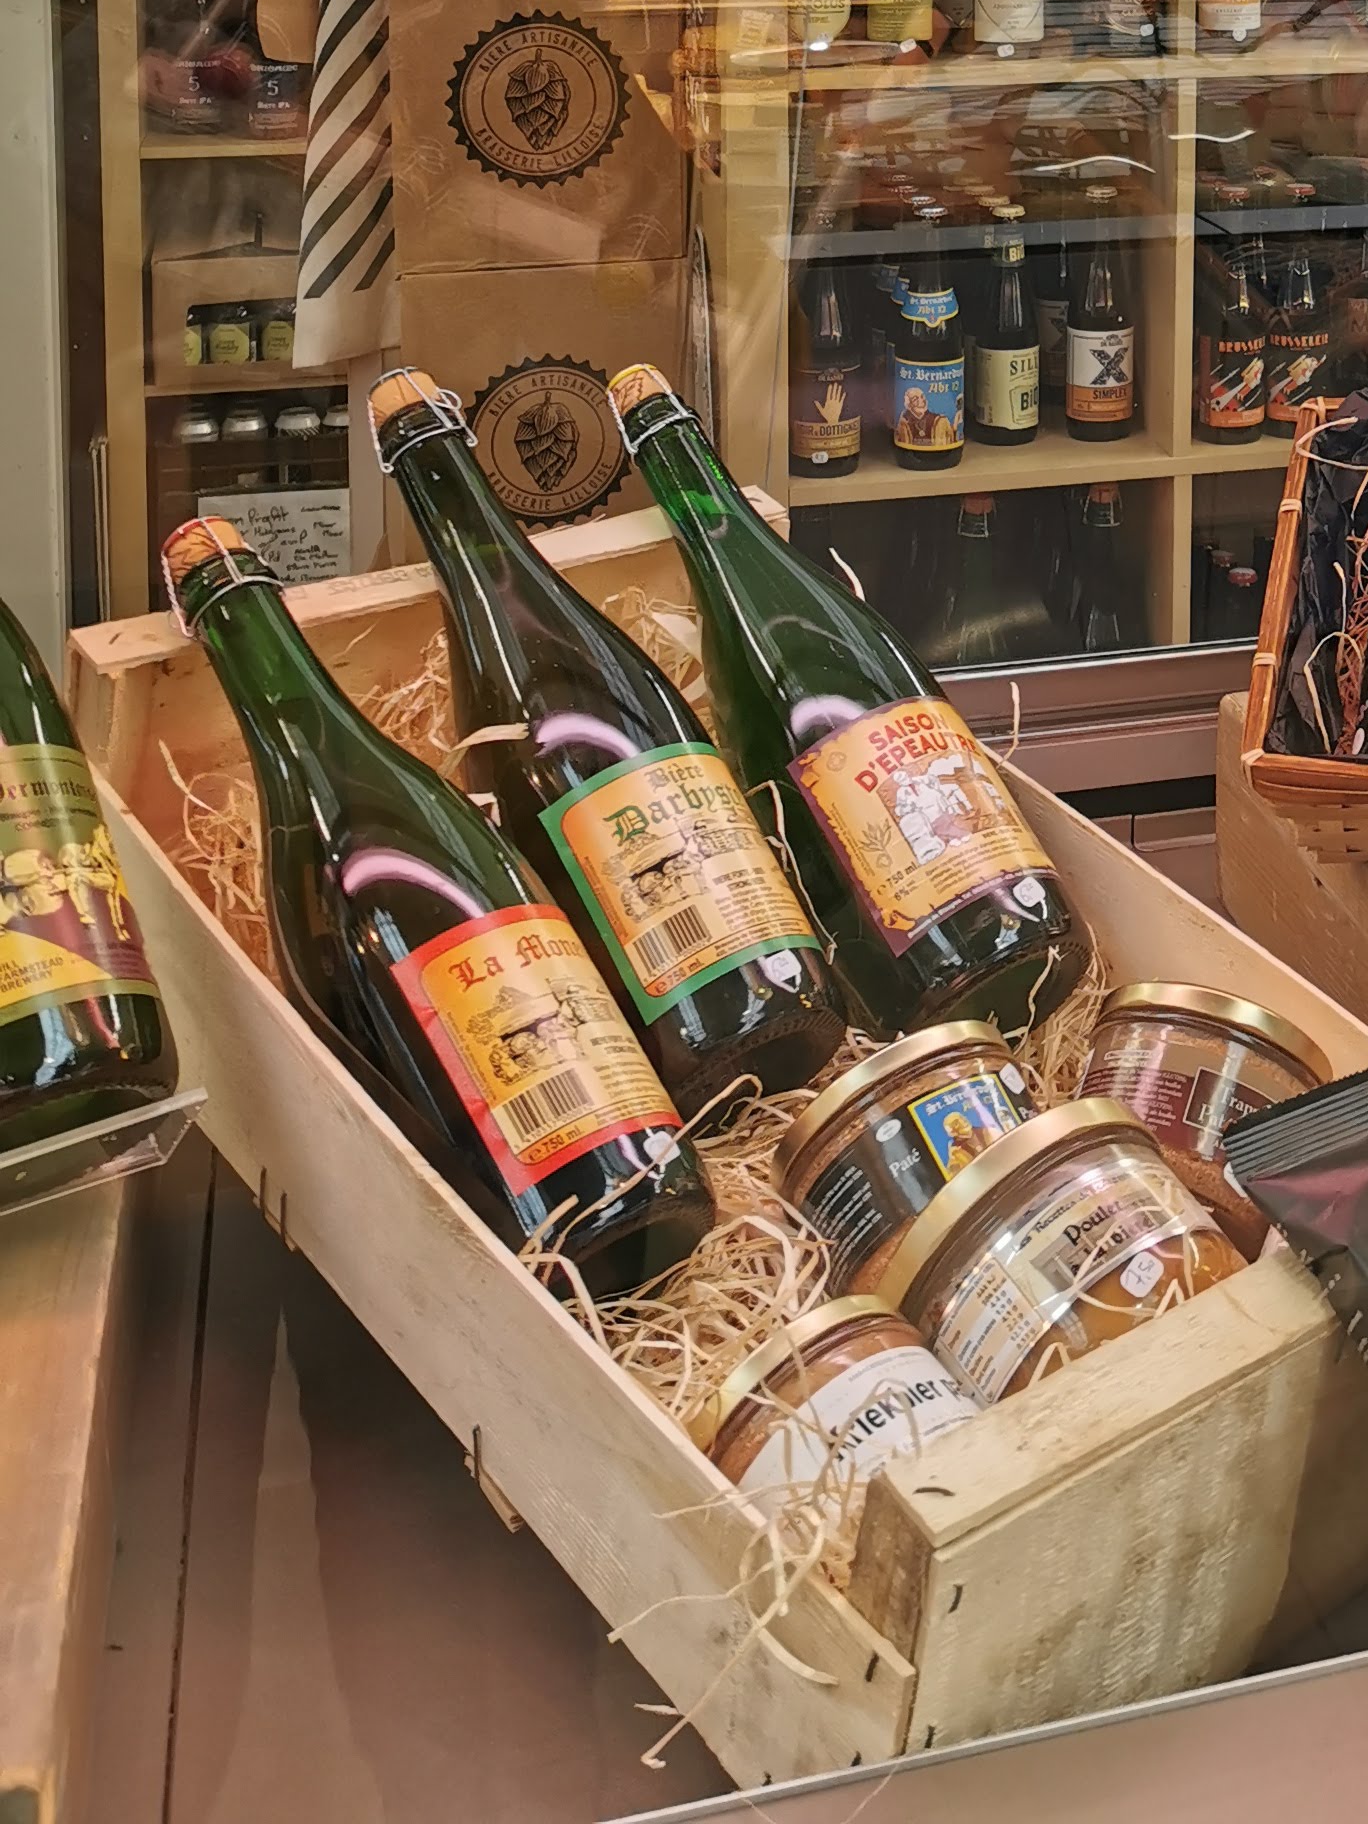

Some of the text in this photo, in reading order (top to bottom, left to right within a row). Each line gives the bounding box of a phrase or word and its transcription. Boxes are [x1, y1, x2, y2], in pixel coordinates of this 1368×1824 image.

[521, 31, 599, 68] ARTISANALE
[267, 80, 279, 96] 5
[475, 115, 606, 170] BRASSERIE LILLOISE
[1009, 359, 1039, 376] SILL
[1092, 388, 1127, 400] SIMPLEX
[561, 462, 613, 507] LILLOISE
[868, 712, 946, 753] SAISON
[644, 763, 704, 792] Bière
[448, 953, 505, 993] La
[1063, 1199, 1124, 1246] Poulet
